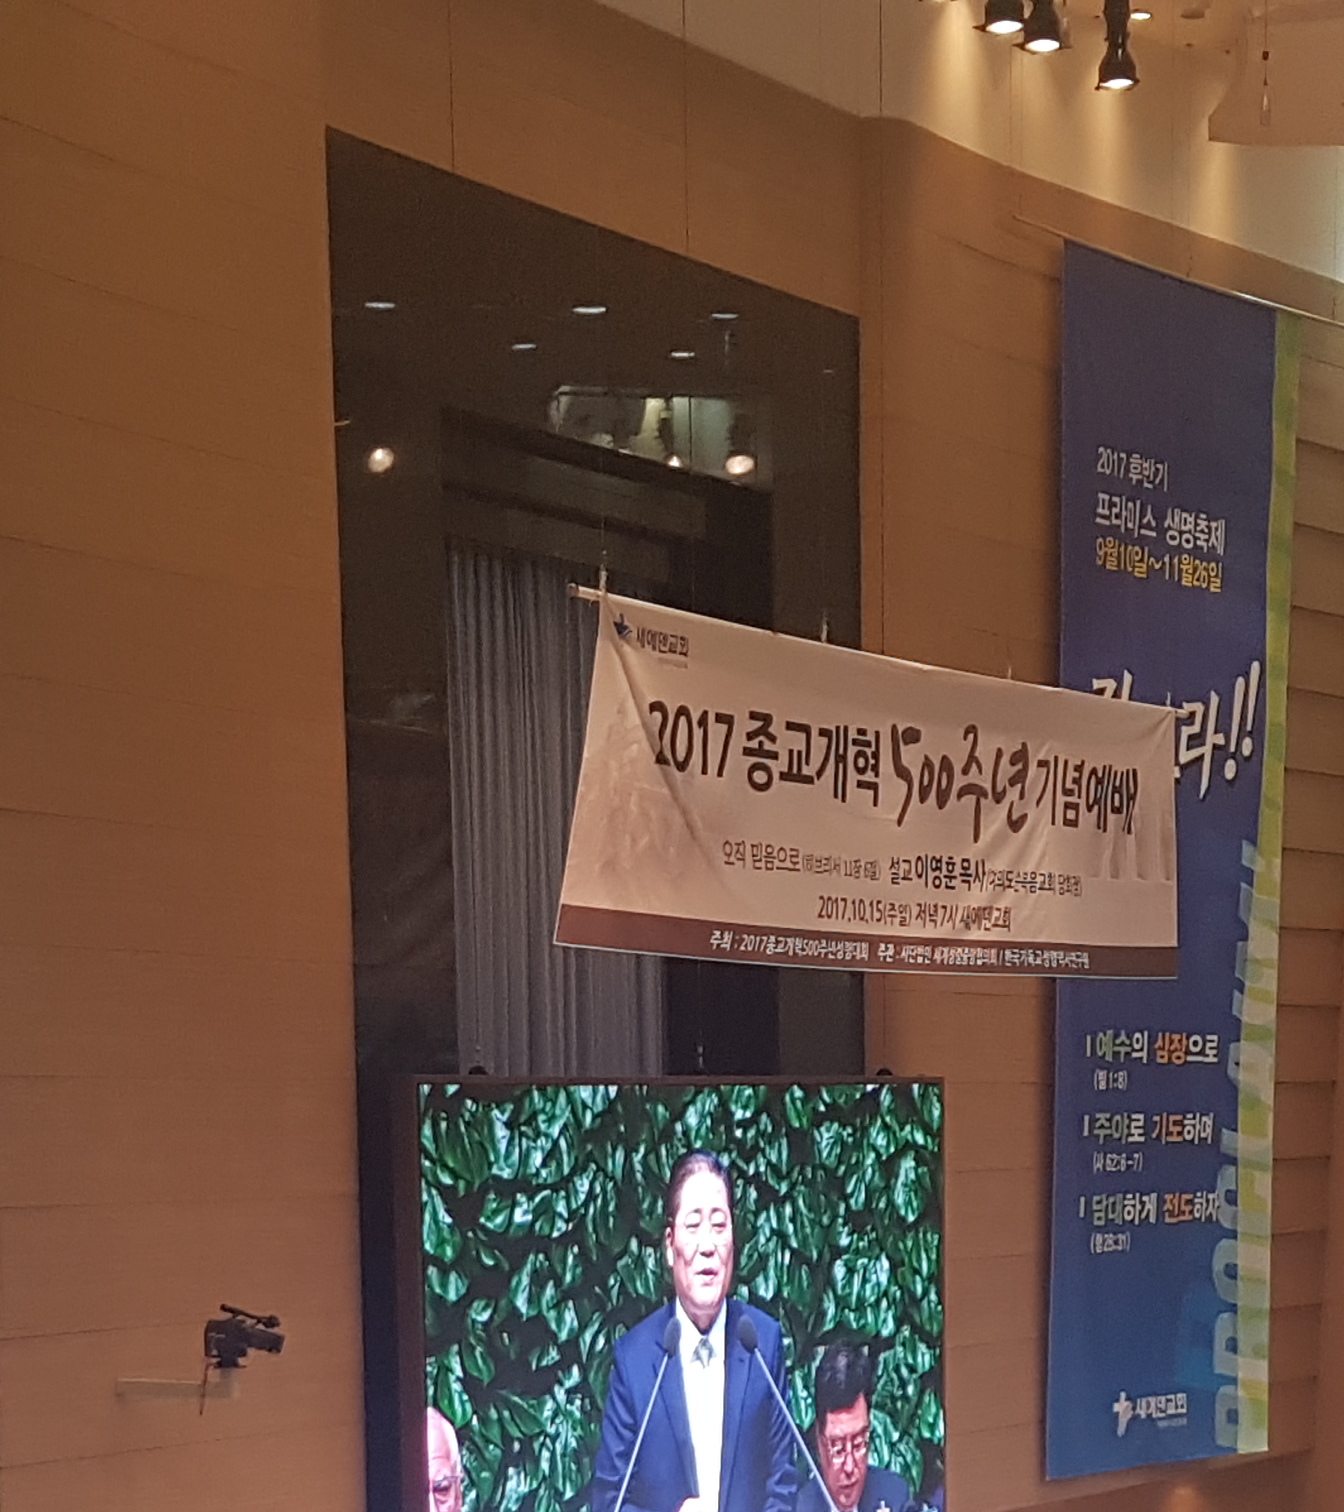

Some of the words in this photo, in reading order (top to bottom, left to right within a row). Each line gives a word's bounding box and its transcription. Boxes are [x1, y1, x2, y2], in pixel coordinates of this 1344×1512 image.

[1096, 445, 1127, 479] 2017
[1128, 453, 1169, 492] 후반기
[1095, 492, 1157, 538] 프라미스
[1163, 507, 1226, 555] 생명축제
[648, 700, 735, 778] 2017
[742, 709, 881, 807] 종교개혁
[722, 839, 747, 869] 오직
[1096, 1029, 1148, 1063] 예수의
[1154, 1031, 1219, 1065] 심장으로
[1093, 1112, 1146, 1144] 주야로
[1152, 1112, 1214, 1144] 기도하며
[1092, 1192, 1158, 1226] 담대하게
[1163, 1190, 1220, 1224] 전도하자
